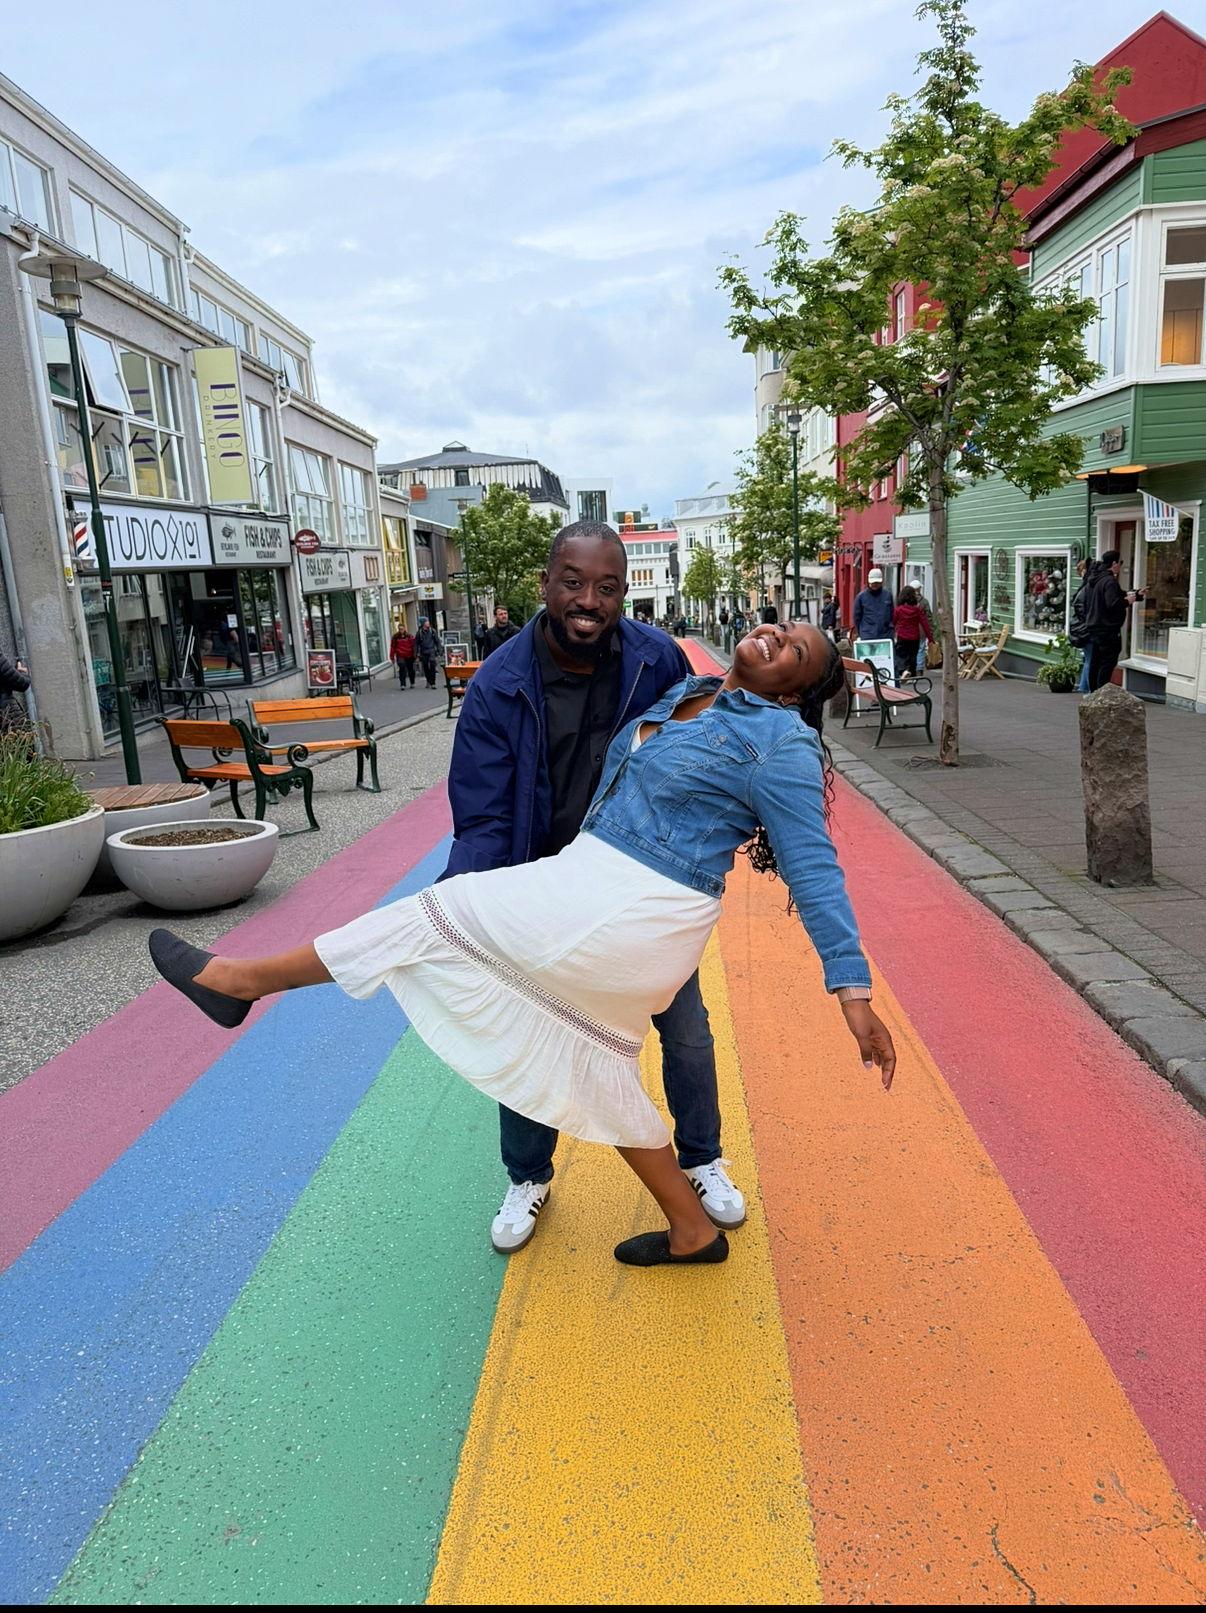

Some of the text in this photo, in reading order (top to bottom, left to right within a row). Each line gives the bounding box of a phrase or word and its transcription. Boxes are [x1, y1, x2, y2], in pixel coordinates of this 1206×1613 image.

[210, 384, 245, 468] BINGO
[1149, 520, 1175, 528] TAX FREE
[1149, 528, 1176, 537] SHOPPING
[102, 515, 168, 561] TUDIO
[244, 525, 259, 548] FISH
[260, 527, 266, 548] &
[265, 527, 282, 549] CHIPS
[306, 557, 317, 576] FISH
[321, 557, 333, 576] CHIPS
